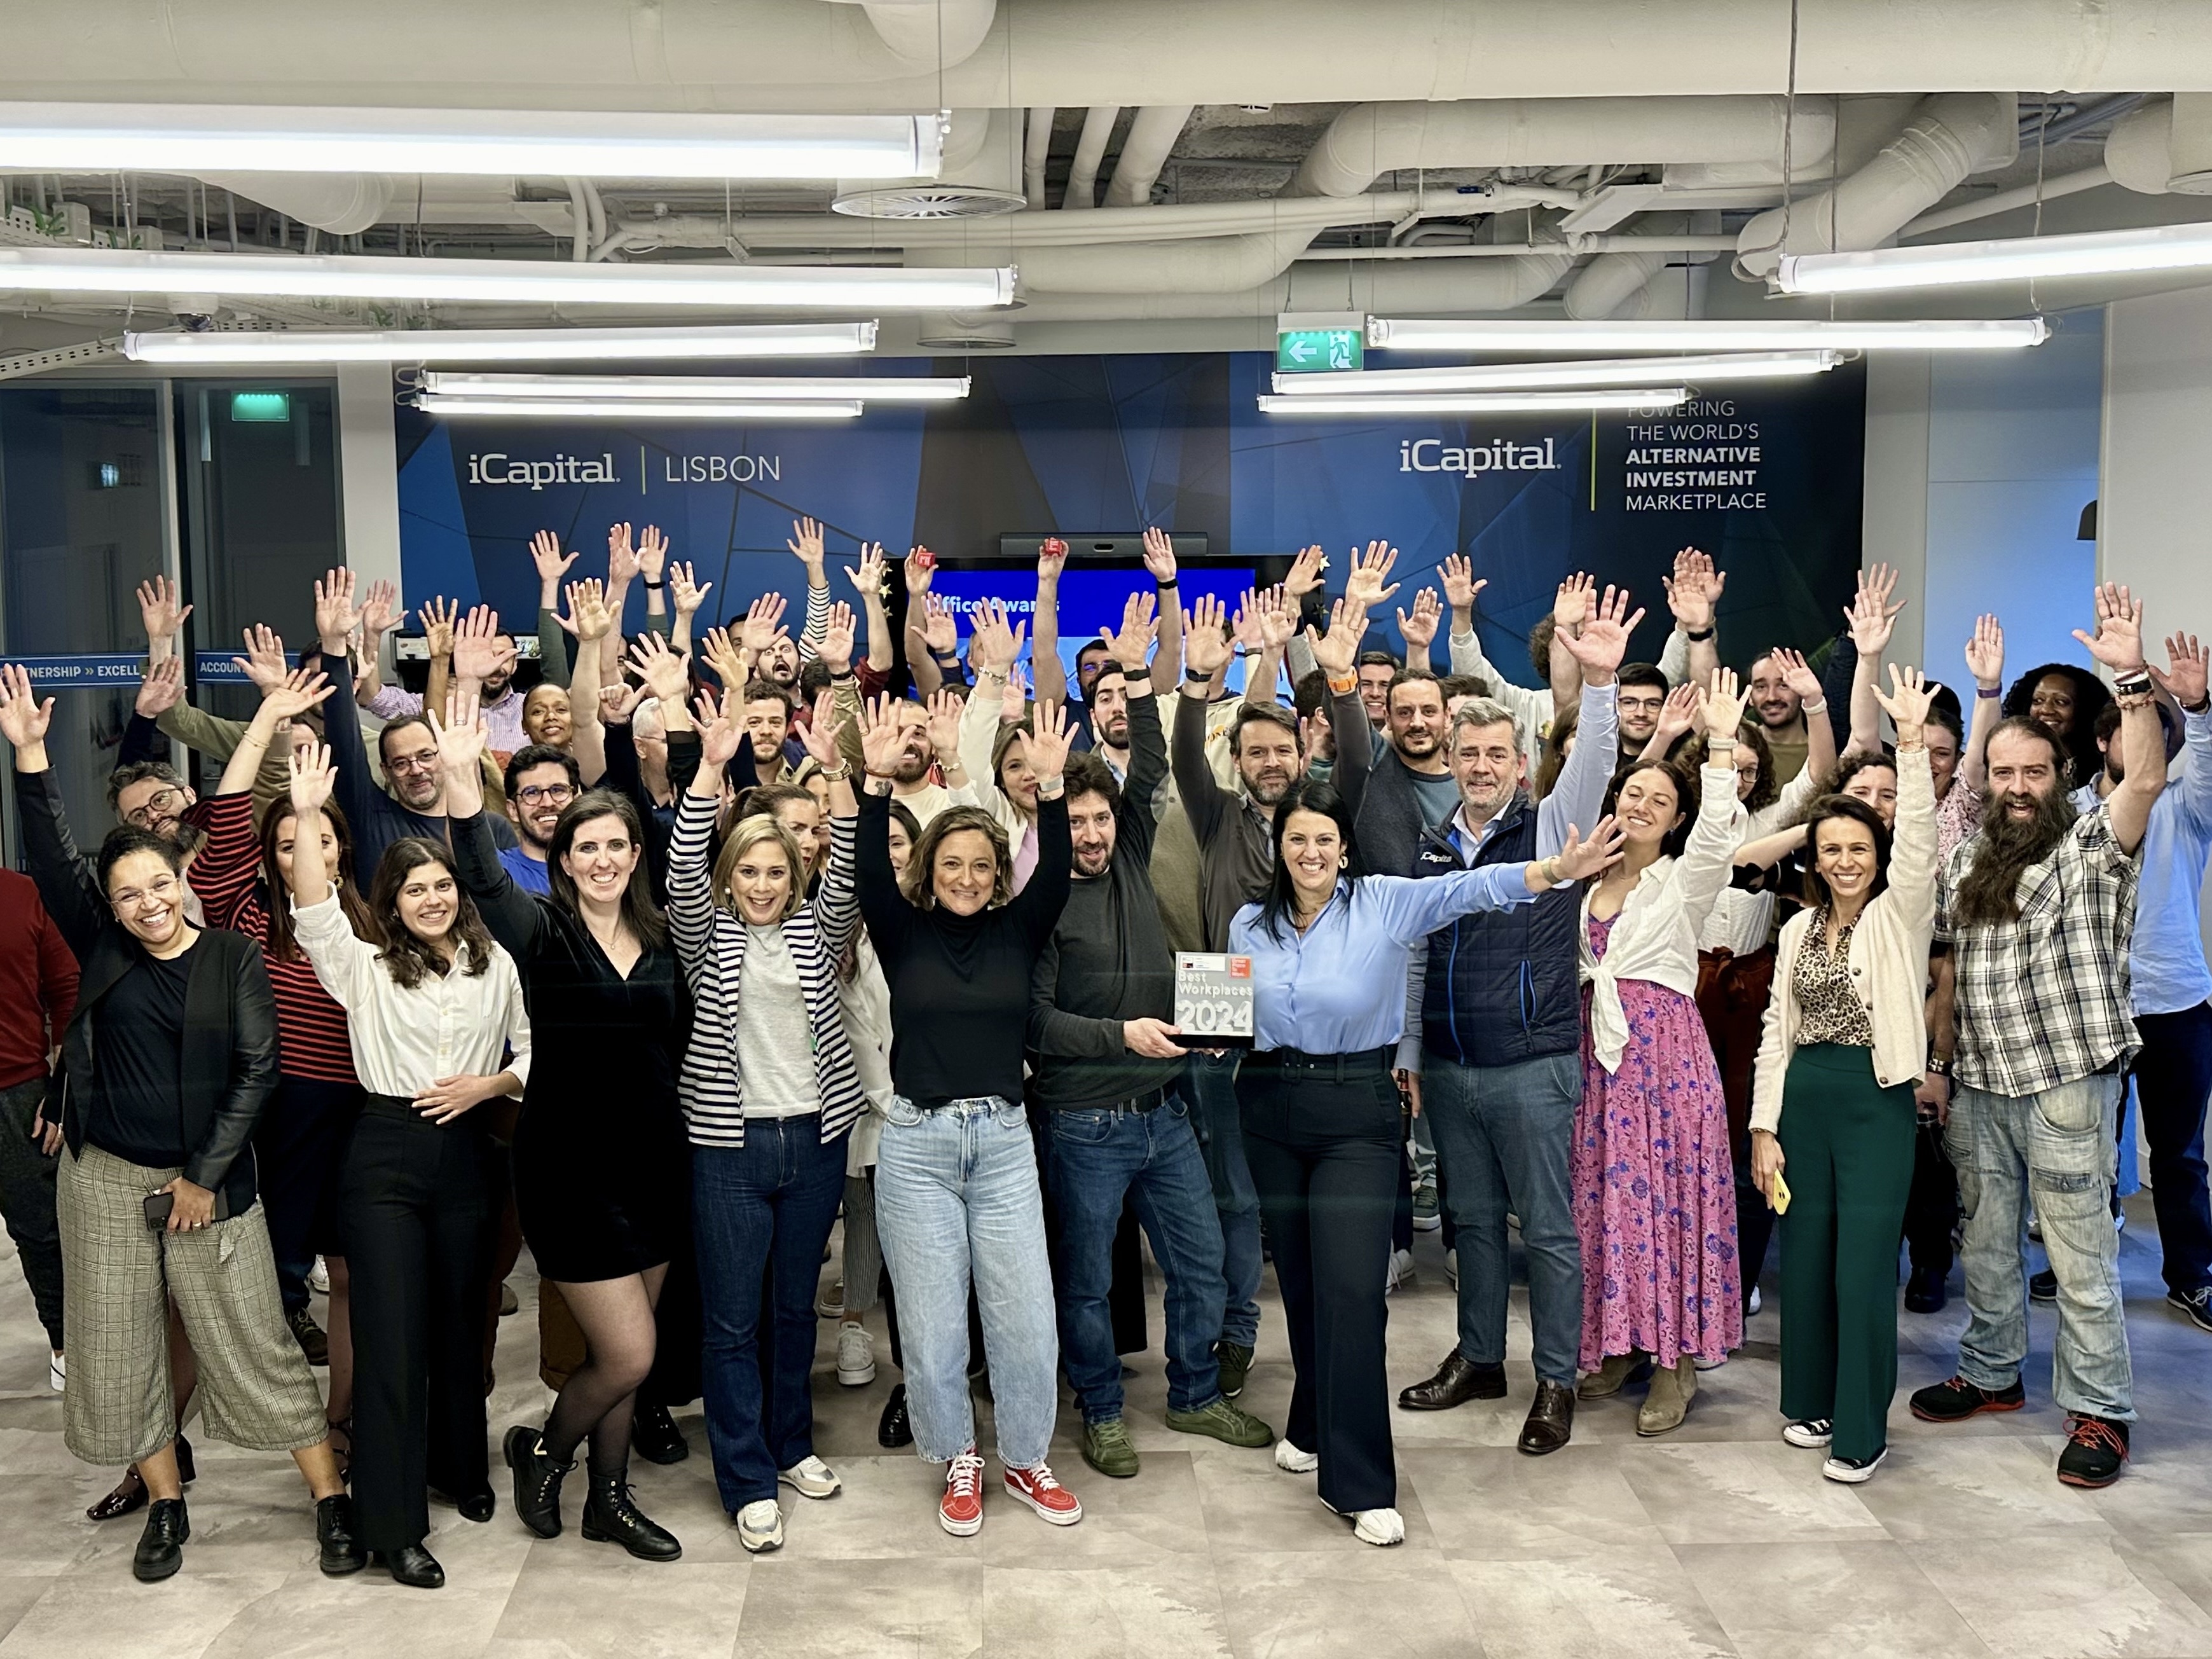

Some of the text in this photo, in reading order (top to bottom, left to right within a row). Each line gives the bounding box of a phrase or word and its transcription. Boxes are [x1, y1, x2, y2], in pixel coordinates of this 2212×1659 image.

[1628, 400, 1735, 418] POWERING
[1626, 423, 1759, 441] THE WORLD'S
[1626, 447, 1761, 464] ALTERNATIVE
[666, 455, 780, 482] LISBON
[1626, 470, 1757, 488] INVESTMENT
[1626, 493, 1766, 511] MARKETPLACE
[200, 661, 245, 673] ACCOUN
[1178, 970, 1206, 982] Best
[1178, 982, 1253, 998] Workplaces
[1176, 1000, 1253, 1033] 2024
